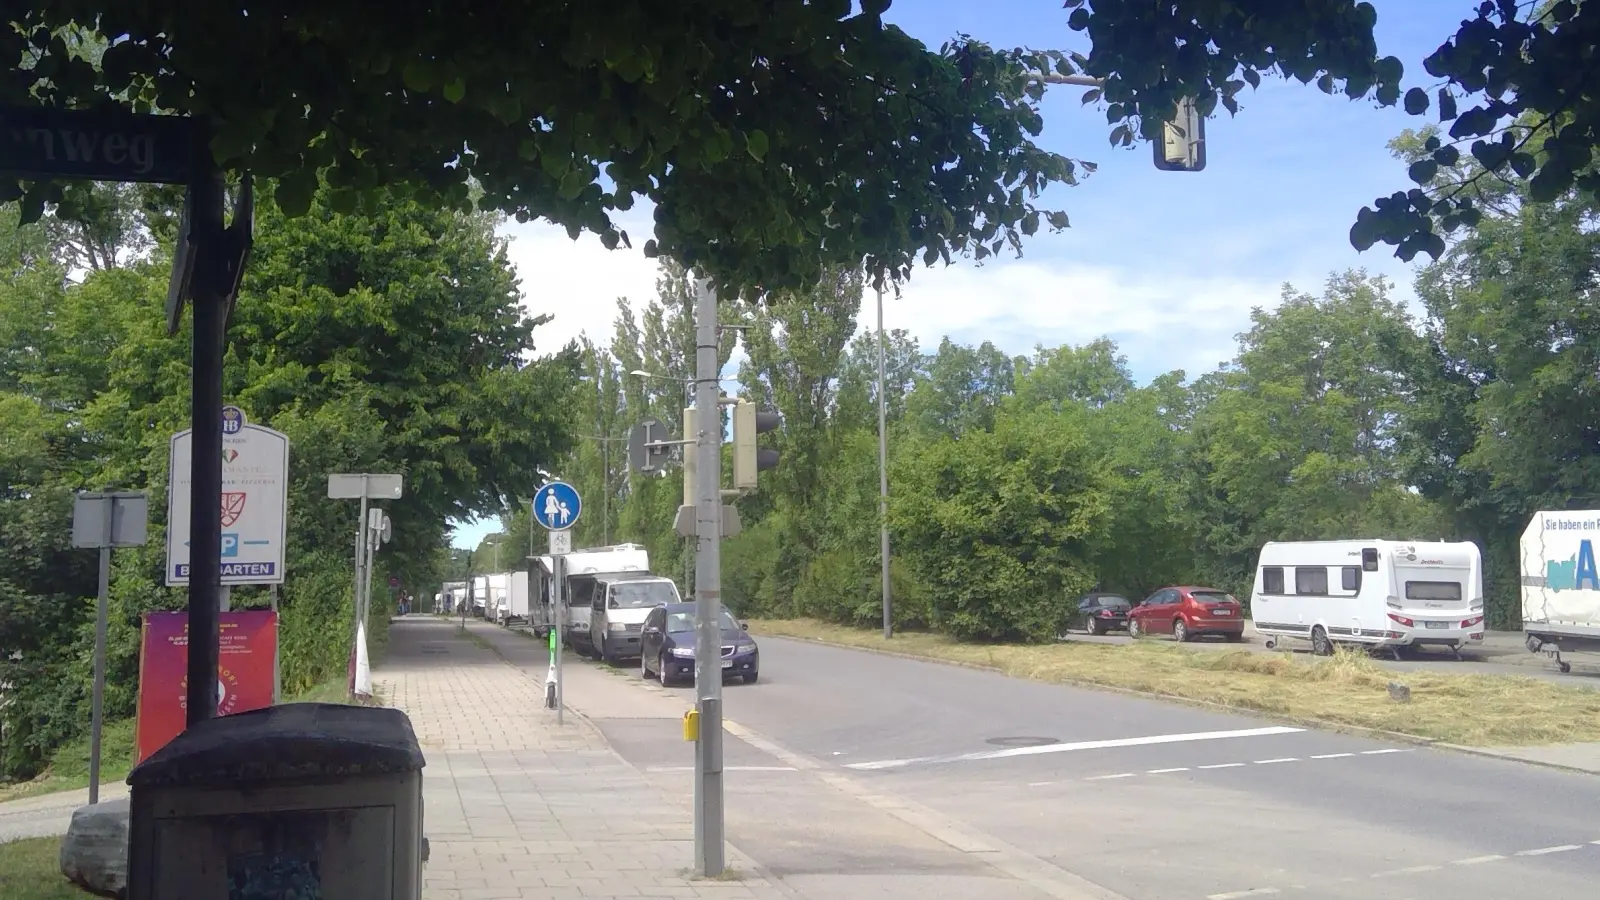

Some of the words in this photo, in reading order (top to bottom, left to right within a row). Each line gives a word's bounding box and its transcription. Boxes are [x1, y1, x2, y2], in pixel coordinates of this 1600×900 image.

[1545, 519, 1557, 530] Sie
[1558, 519, 1581, 530] haben
[1583, 519, 1595, 530] ein
[180, 564, 269, 576] BARTEN
